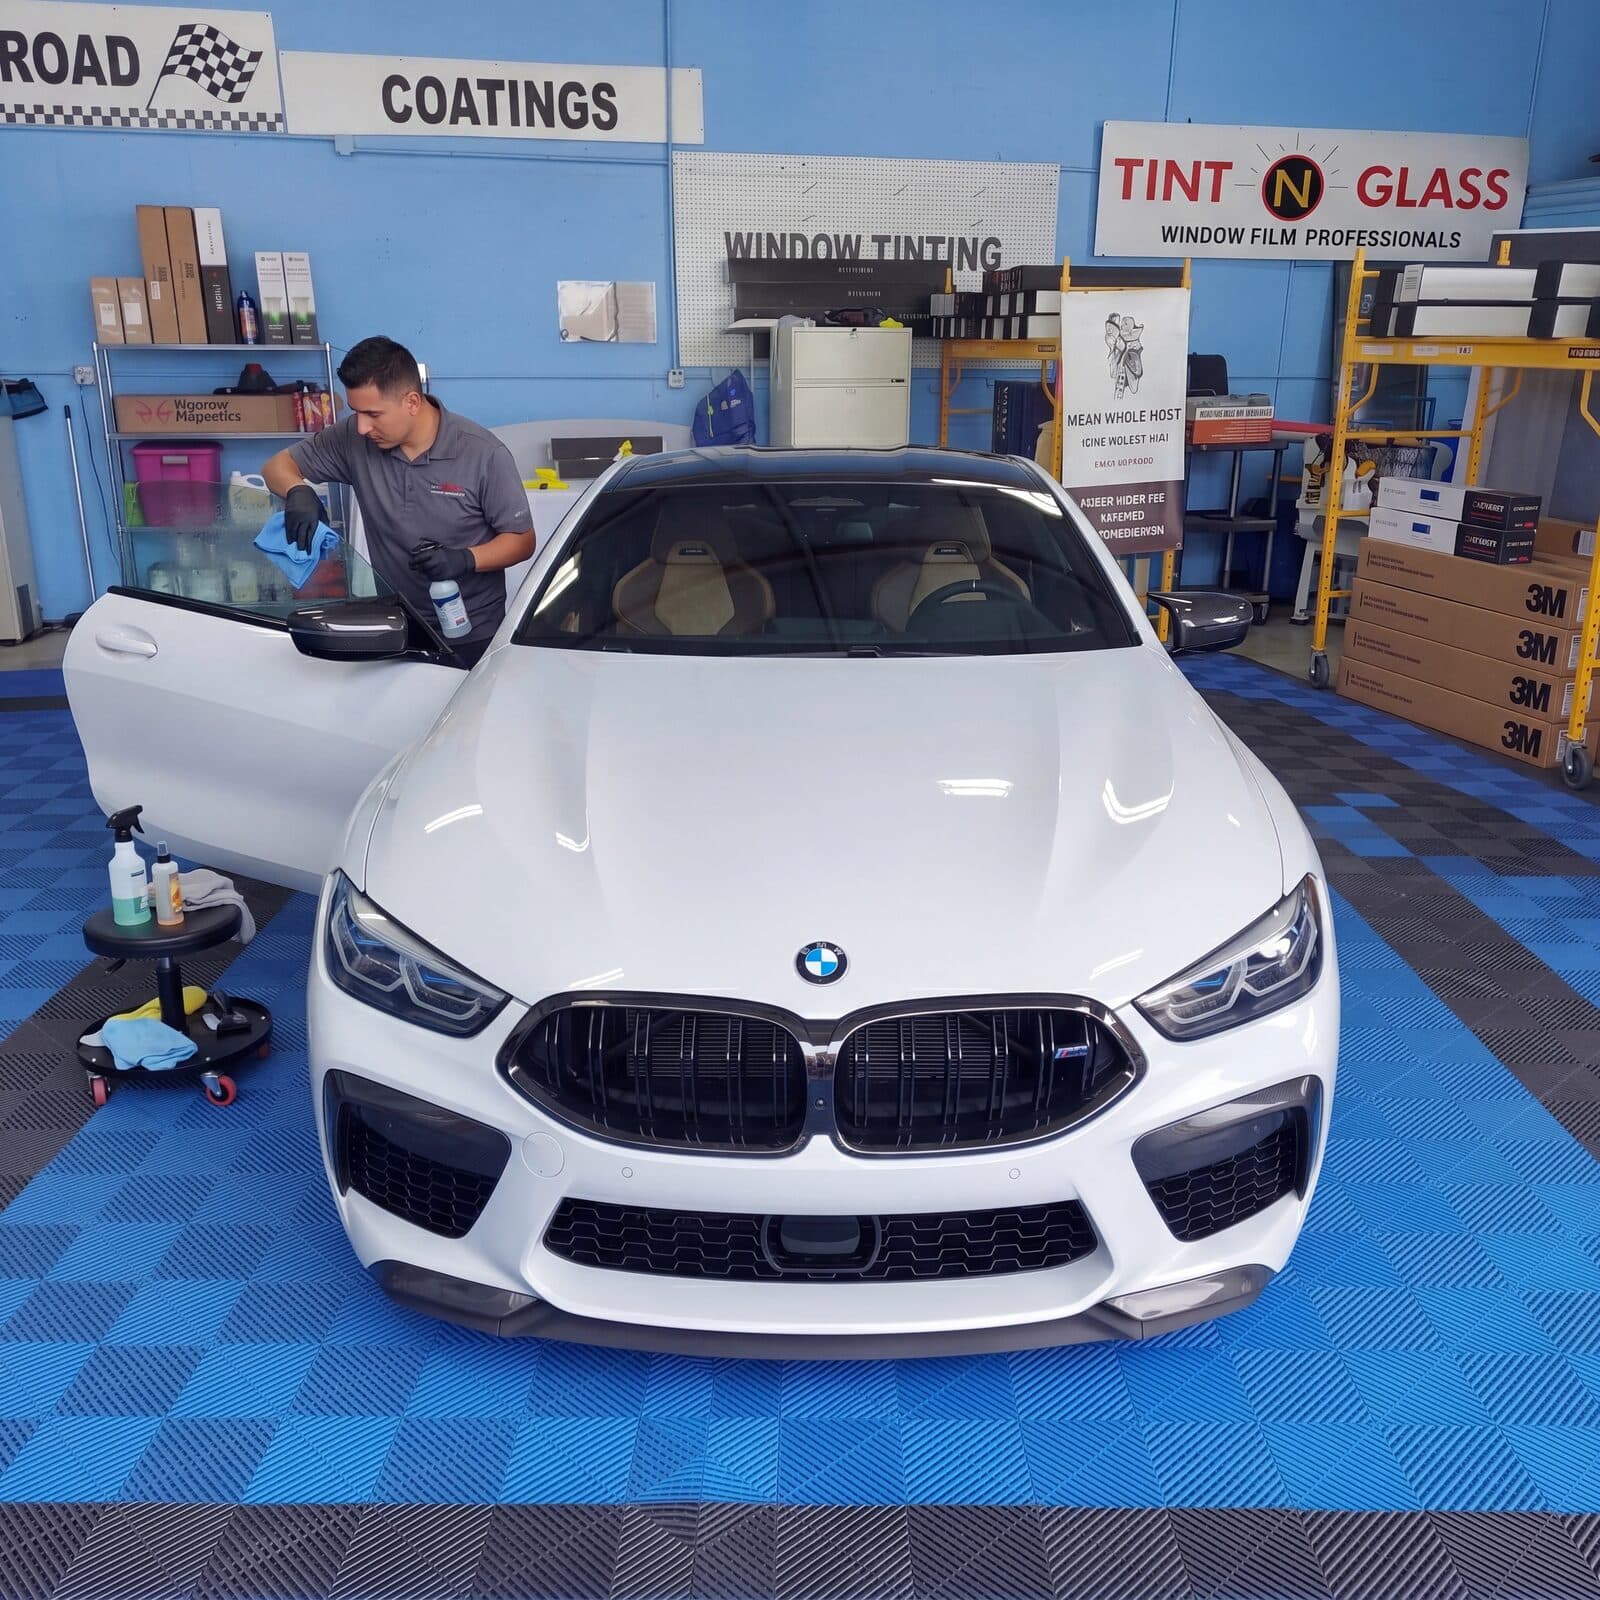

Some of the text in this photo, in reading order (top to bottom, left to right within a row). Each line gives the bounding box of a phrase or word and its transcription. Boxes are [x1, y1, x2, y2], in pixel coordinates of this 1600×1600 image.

[0, 30, 140, 87] ROAD
[381, 73, 618, 131] COATINGS
[1114, 157, 1511, 211] TINT N GLASS
[724, 231, 1002, 271] WINDOW TINTING
[1161, 225, 1462, 248] WINDOW FILM PROFESSIONALS
[1067, 408, 1182, 427] MEAN WHOLE HOST
[1116, 494, 1146, 506] HIDER
[1148, 492, 1166, 504] FEE
[1525, 583, 1567, 618] 3M
[1516, 630, 1558, 665] 3M
[1509, 676, 1552, 713] 3M
[1501, 720, 1542, 758] 3M
